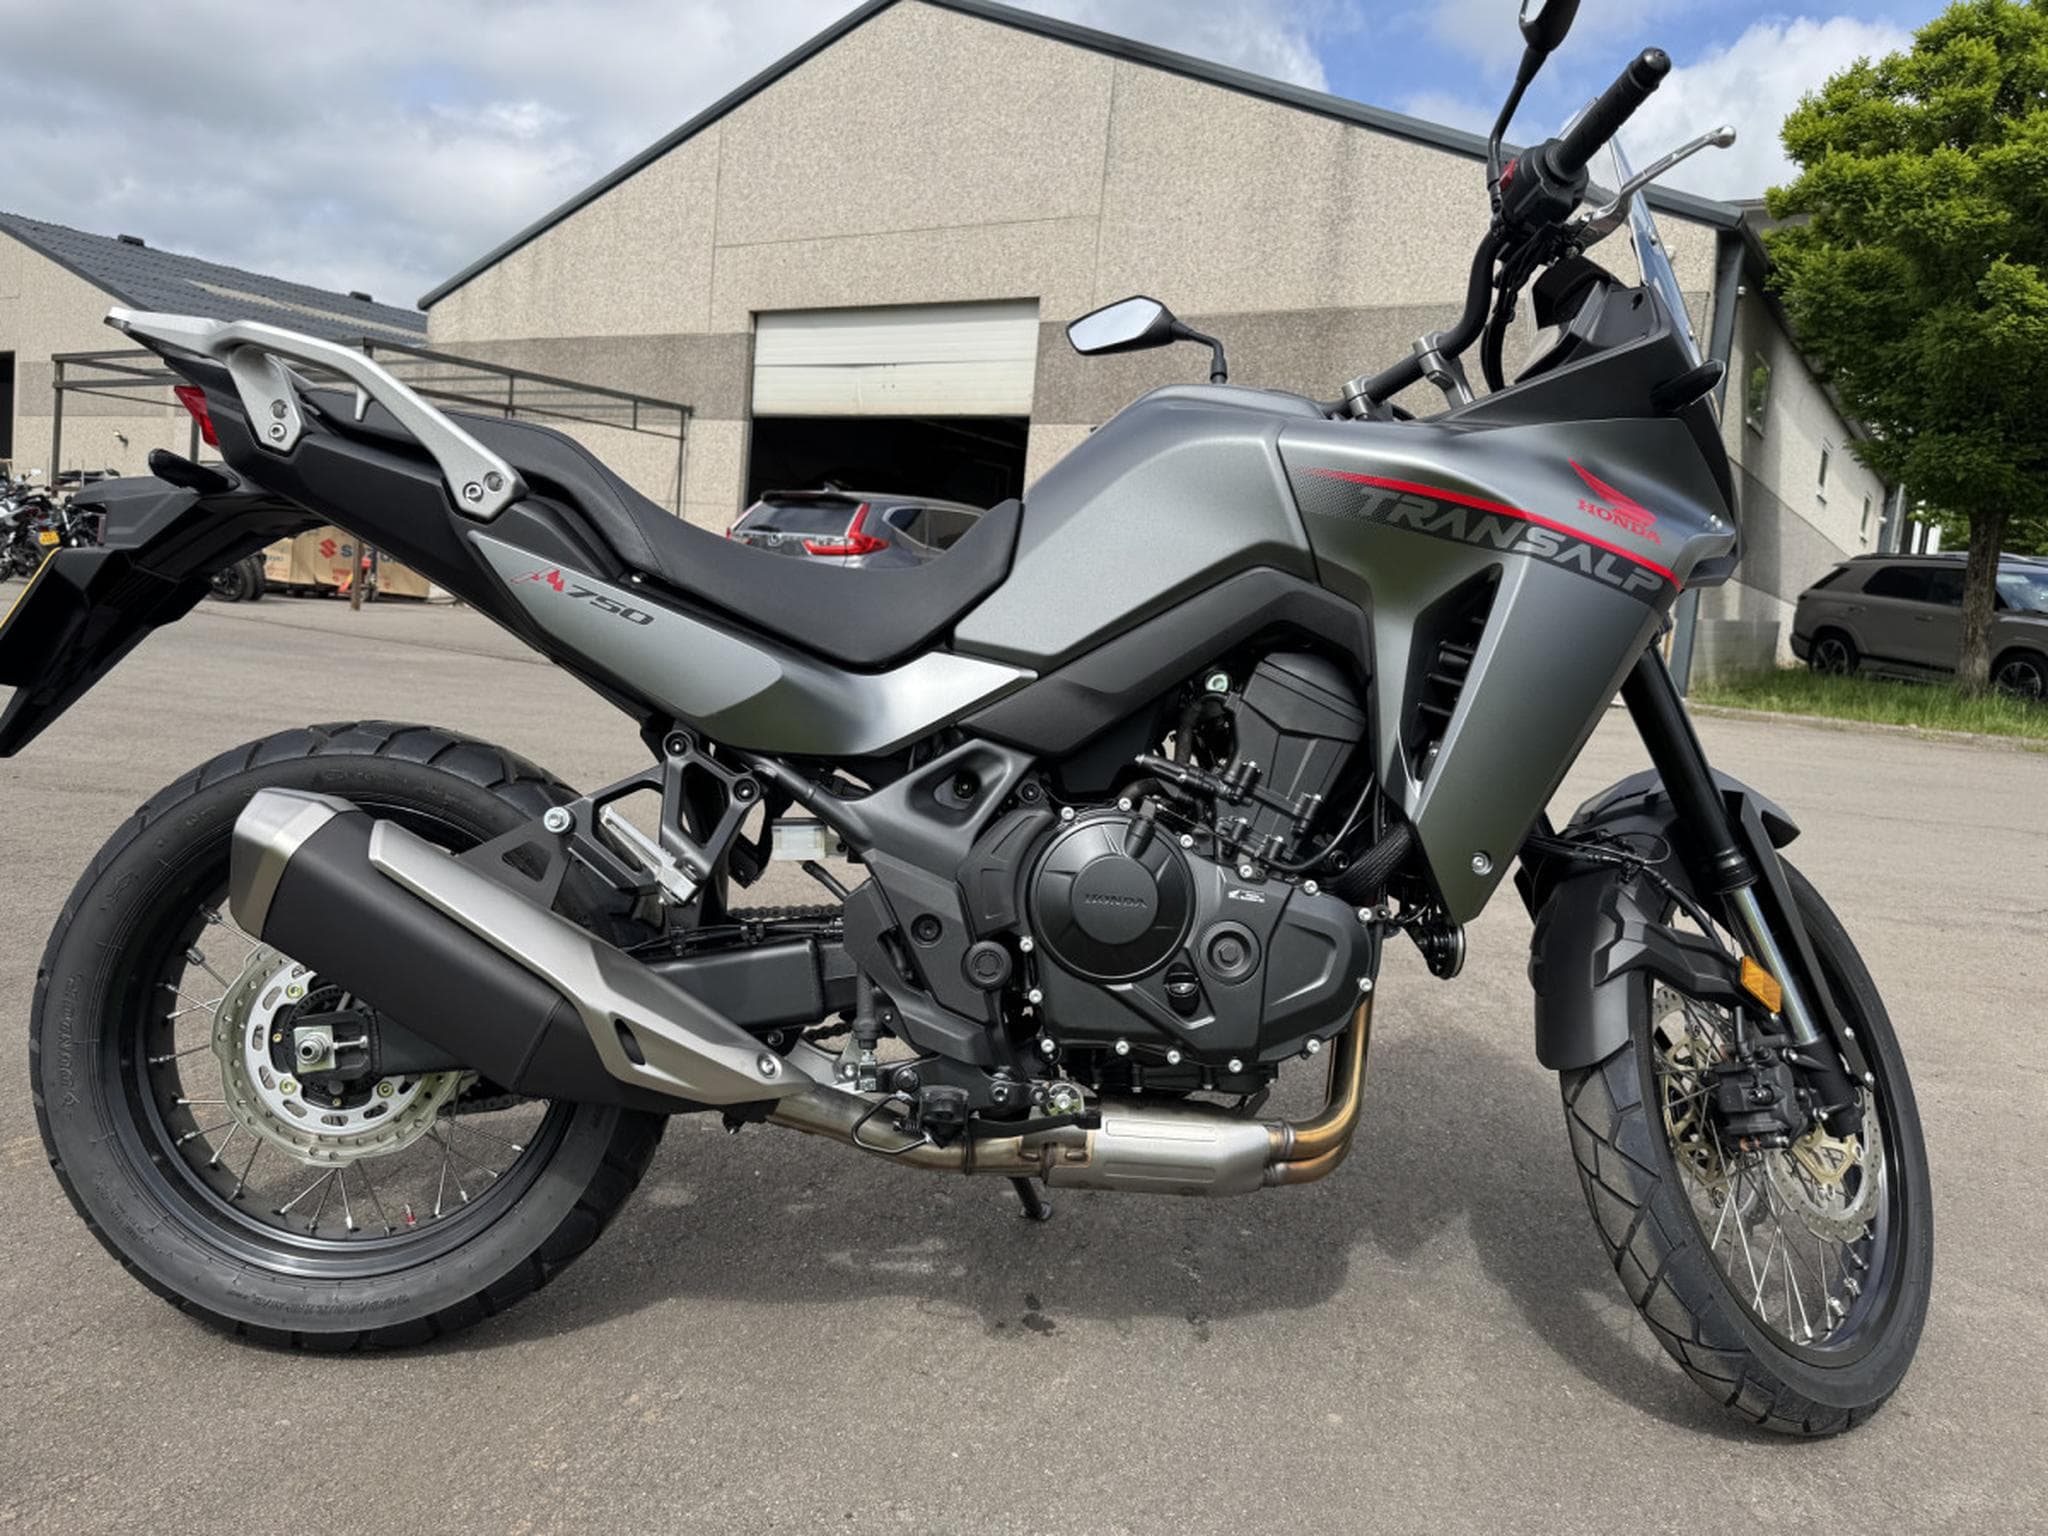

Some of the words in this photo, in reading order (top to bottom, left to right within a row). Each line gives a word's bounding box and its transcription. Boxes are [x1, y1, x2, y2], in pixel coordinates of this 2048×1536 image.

[1360, 489, 1664, 592] TRANSALP
[1577, 498, 1662, 546] HONDA
[566, 584, 655, 625] 750
[1085, 893, 1148, 909] HONDA
